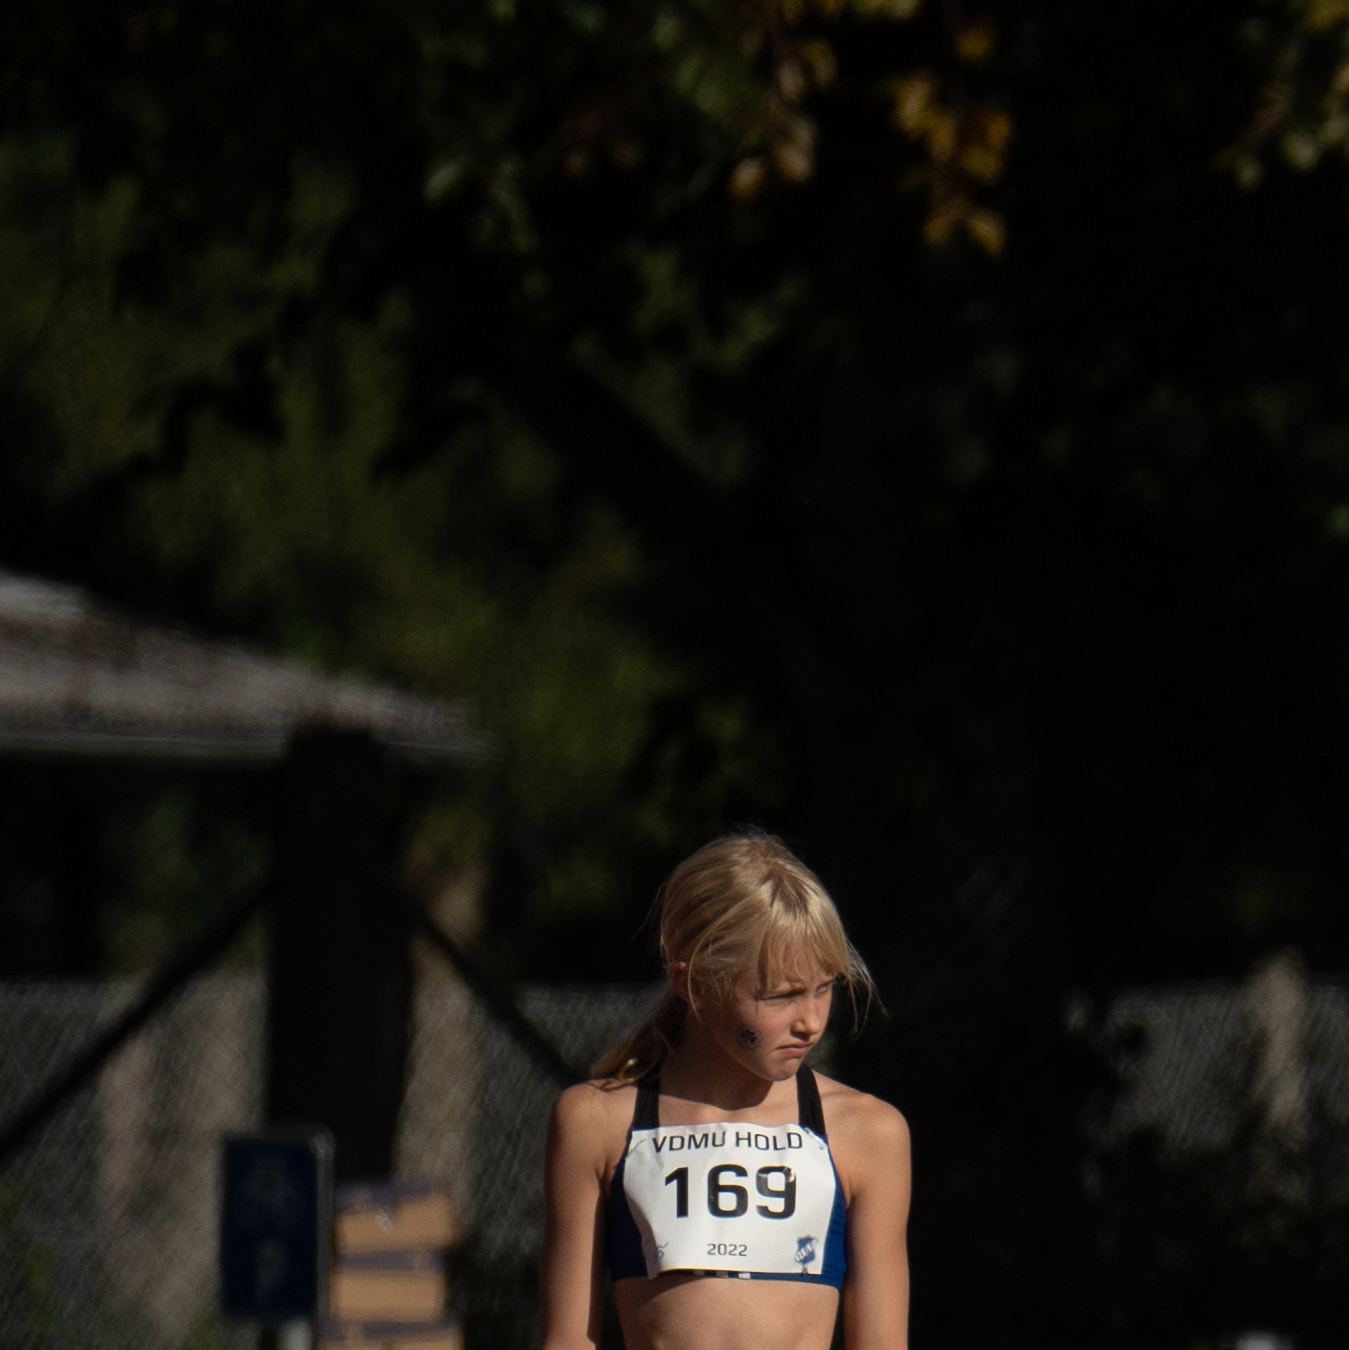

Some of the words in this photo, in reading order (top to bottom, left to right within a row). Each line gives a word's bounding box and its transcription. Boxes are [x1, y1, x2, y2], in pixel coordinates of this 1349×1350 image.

[652, 1131, 726, 1153] VDMU
[735, 1131, 803, 1151] HOLD
[664, 1163, 797, 1220] 169
[706, 1243, 748, 1257] 2022
